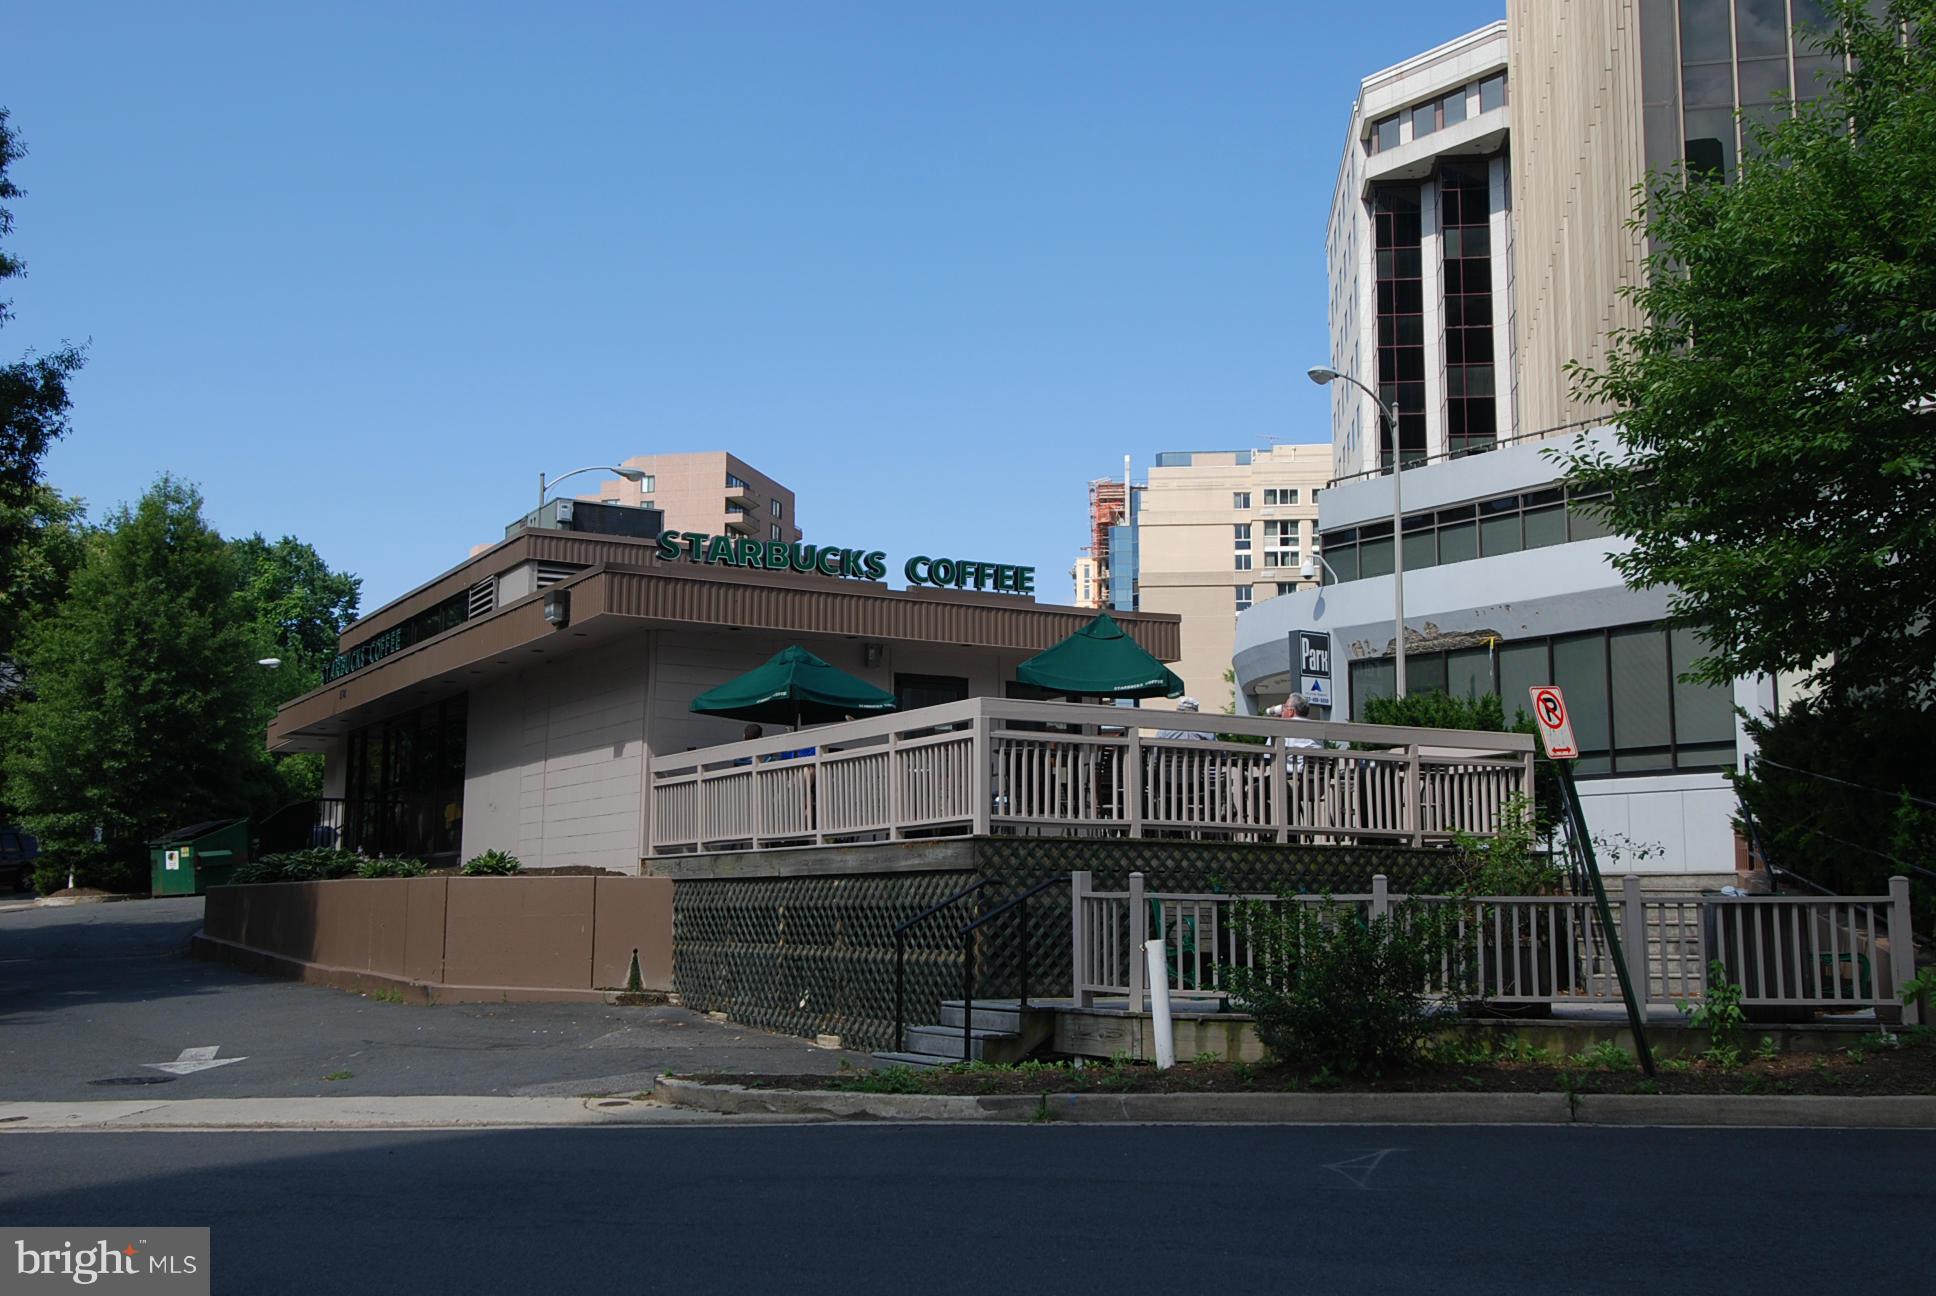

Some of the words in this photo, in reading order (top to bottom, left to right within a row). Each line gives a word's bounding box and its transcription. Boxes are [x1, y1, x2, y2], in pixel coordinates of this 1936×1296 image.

[656, 529, 888, 580] STARBUCKS
[904, 555, 1036, 592] COFFEE
[369, 628, 401, 664] COFFEE
